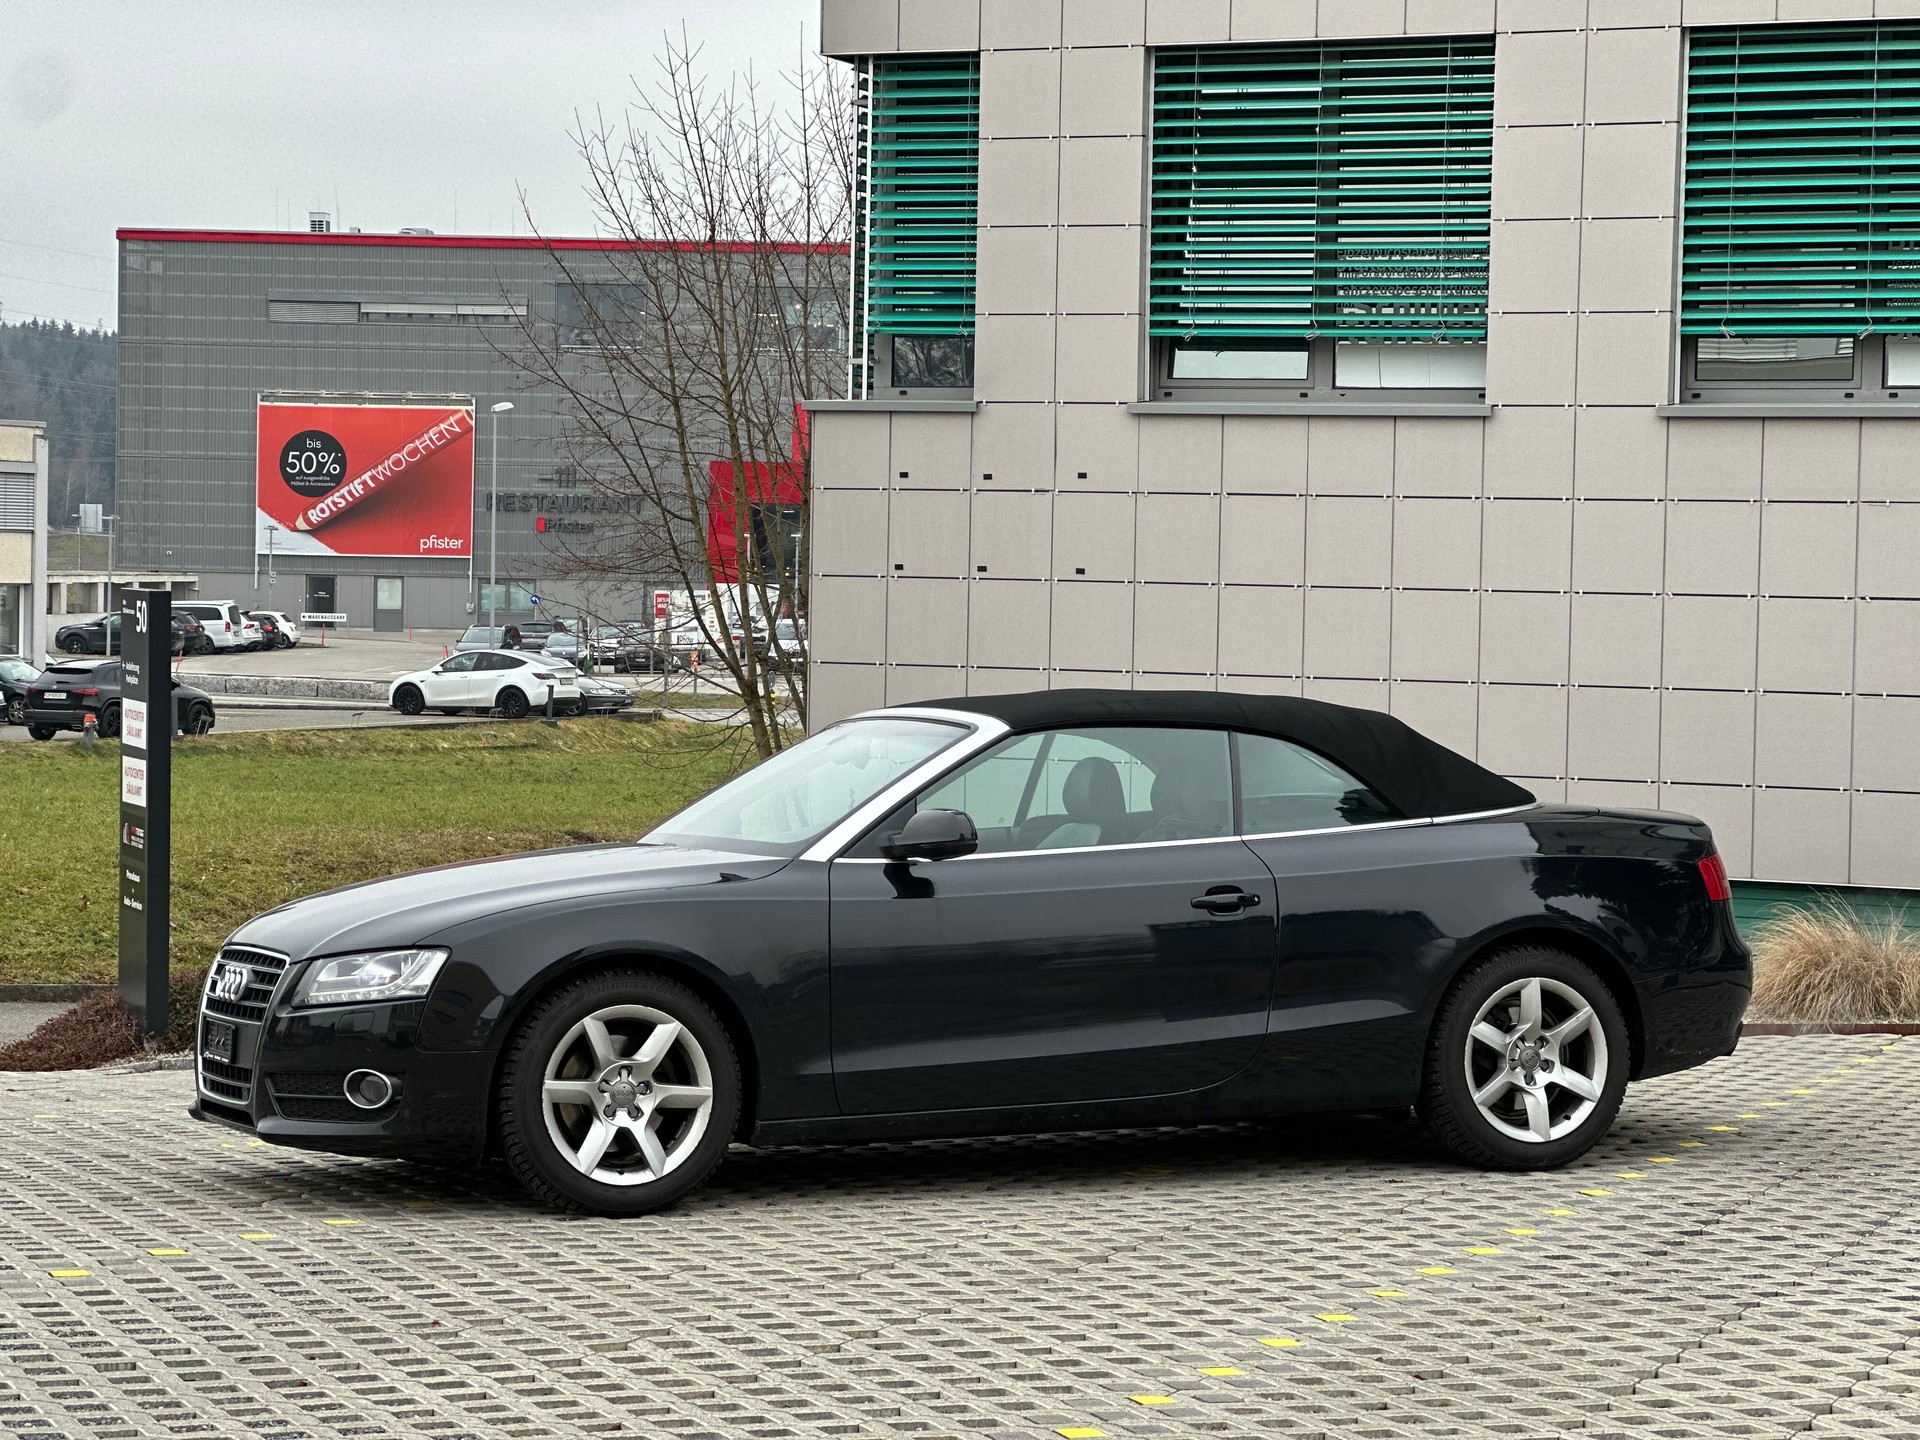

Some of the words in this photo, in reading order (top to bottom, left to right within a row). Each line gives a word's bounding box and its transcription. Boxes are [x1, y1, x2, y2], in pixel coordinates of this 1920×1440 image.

[306, 438, 322, 449] bis
[307, 416, 462, 524] ROTSTIFTWOCHEN
[486, 493, 645, 514] RESTAURANT
[419, 535, 463, 552] pfister
[135, 600, 147, 633] 50
